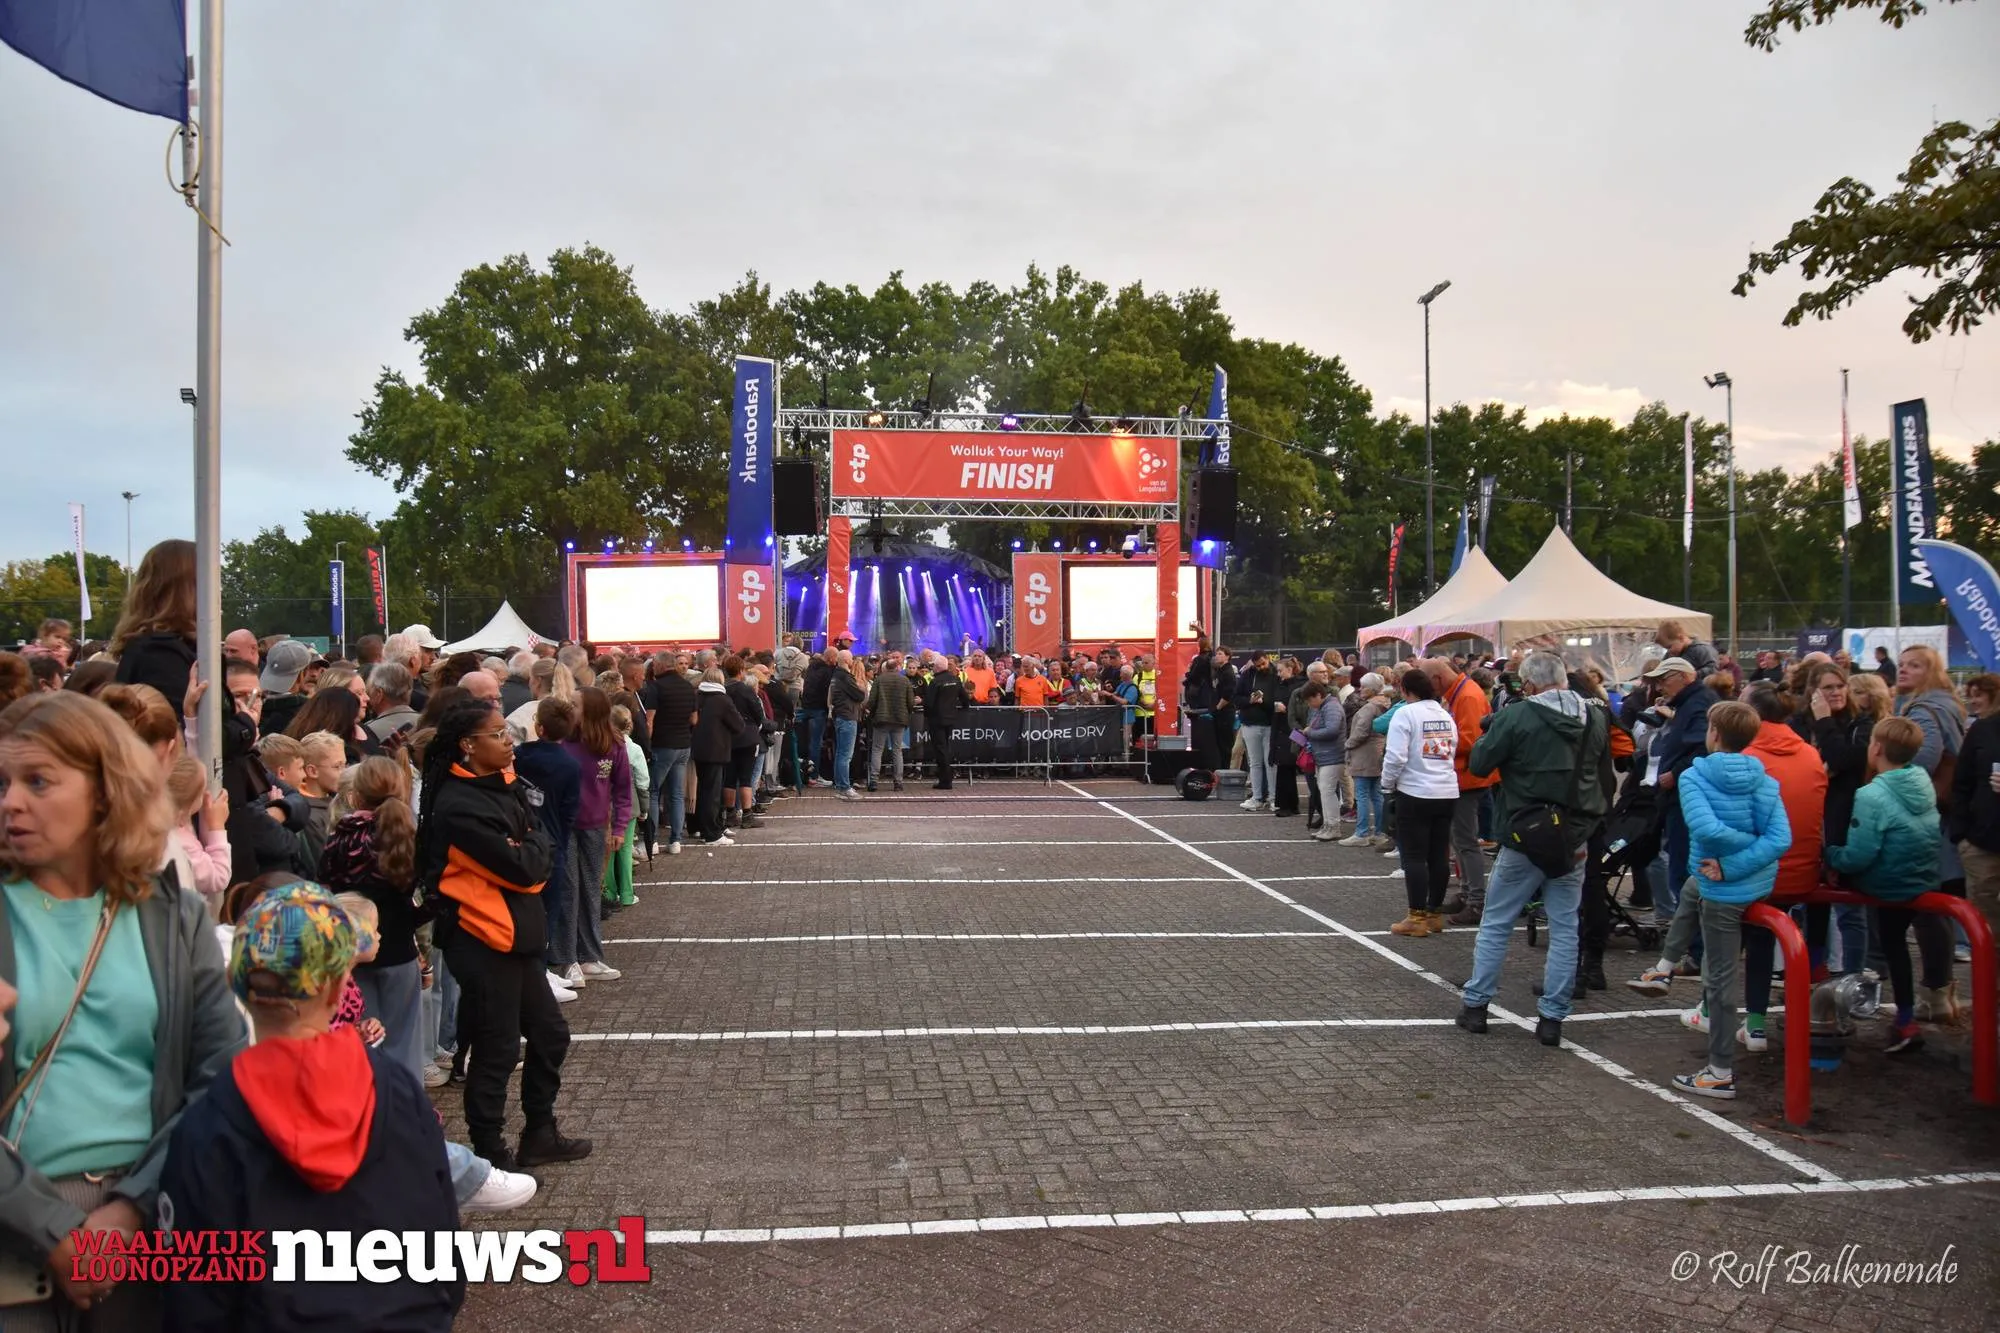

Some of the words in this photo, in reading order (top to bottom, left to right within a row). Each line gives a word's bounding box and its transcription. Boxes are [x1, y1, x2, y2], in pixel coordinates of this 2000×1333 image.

[849, 443, 870, 484] ctp
[950, 445, 994, 457] Wolluk
[998, 445, 1029, 458] Your
[1032, 446, 1064, 461] Way!
[960, 462, 1054, 490] FINISH
[738, 569, 766, 624] ctp
[1024, 572, 1052, 626] ctp
[916, 728, 971, 743] MRE
[974, 728, 1005, 741] DRV
[1075, 725, 1106, 739] DRV
